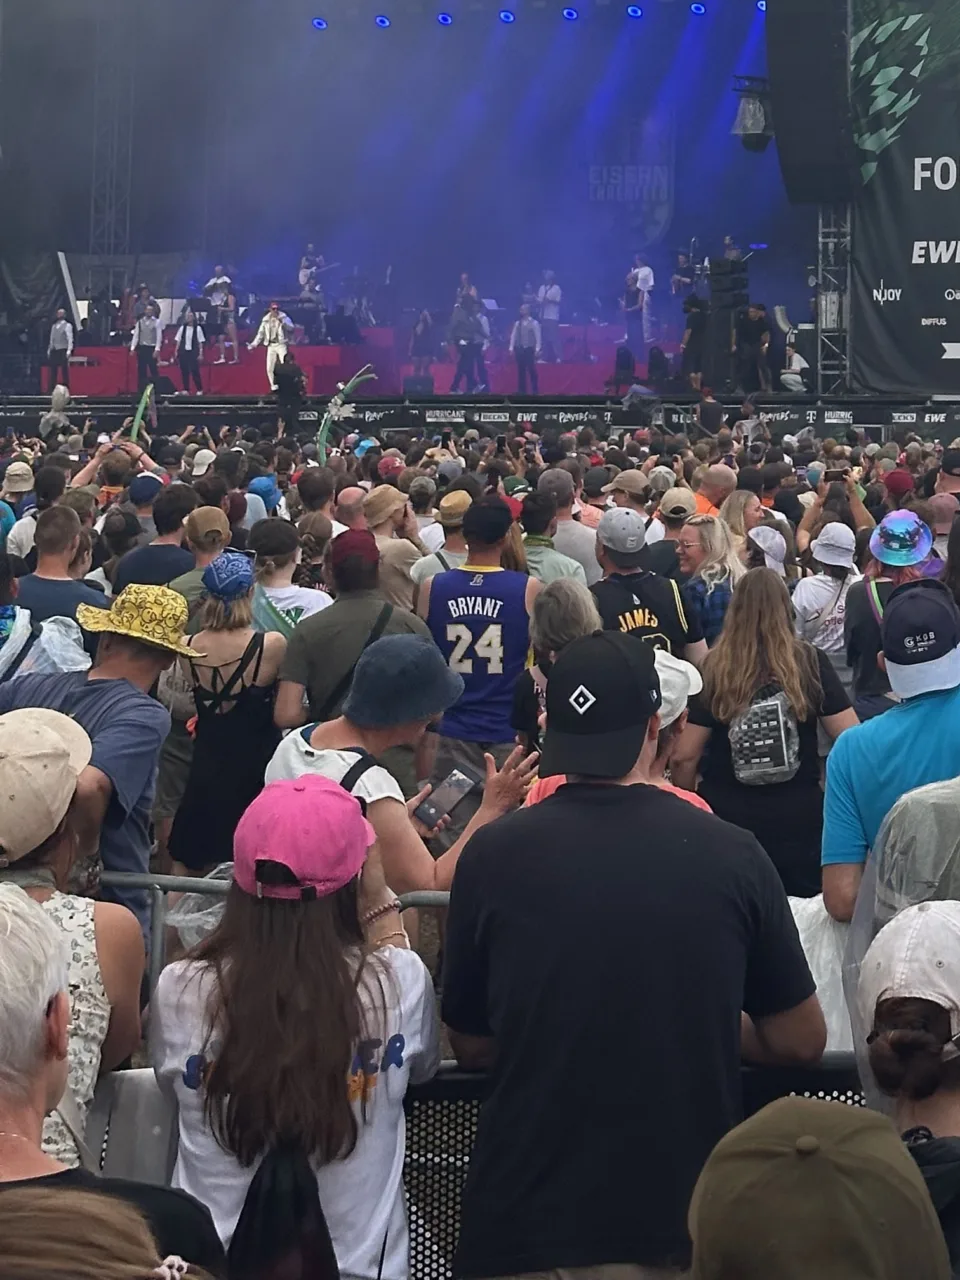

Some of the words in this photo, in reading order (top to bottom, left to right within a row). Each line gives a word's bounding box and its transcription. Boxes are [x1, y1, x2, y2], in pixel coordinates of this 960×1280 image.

[517, 413, 538, 422] EWE
[559, 411, 588, 423] PLAYERS
[924, 413, 946, 423] EWE
[447, 596, 504, 618] BRYANT
[618, 607, 659, 633] JAMES
[446, 623, 504, 674] 24
